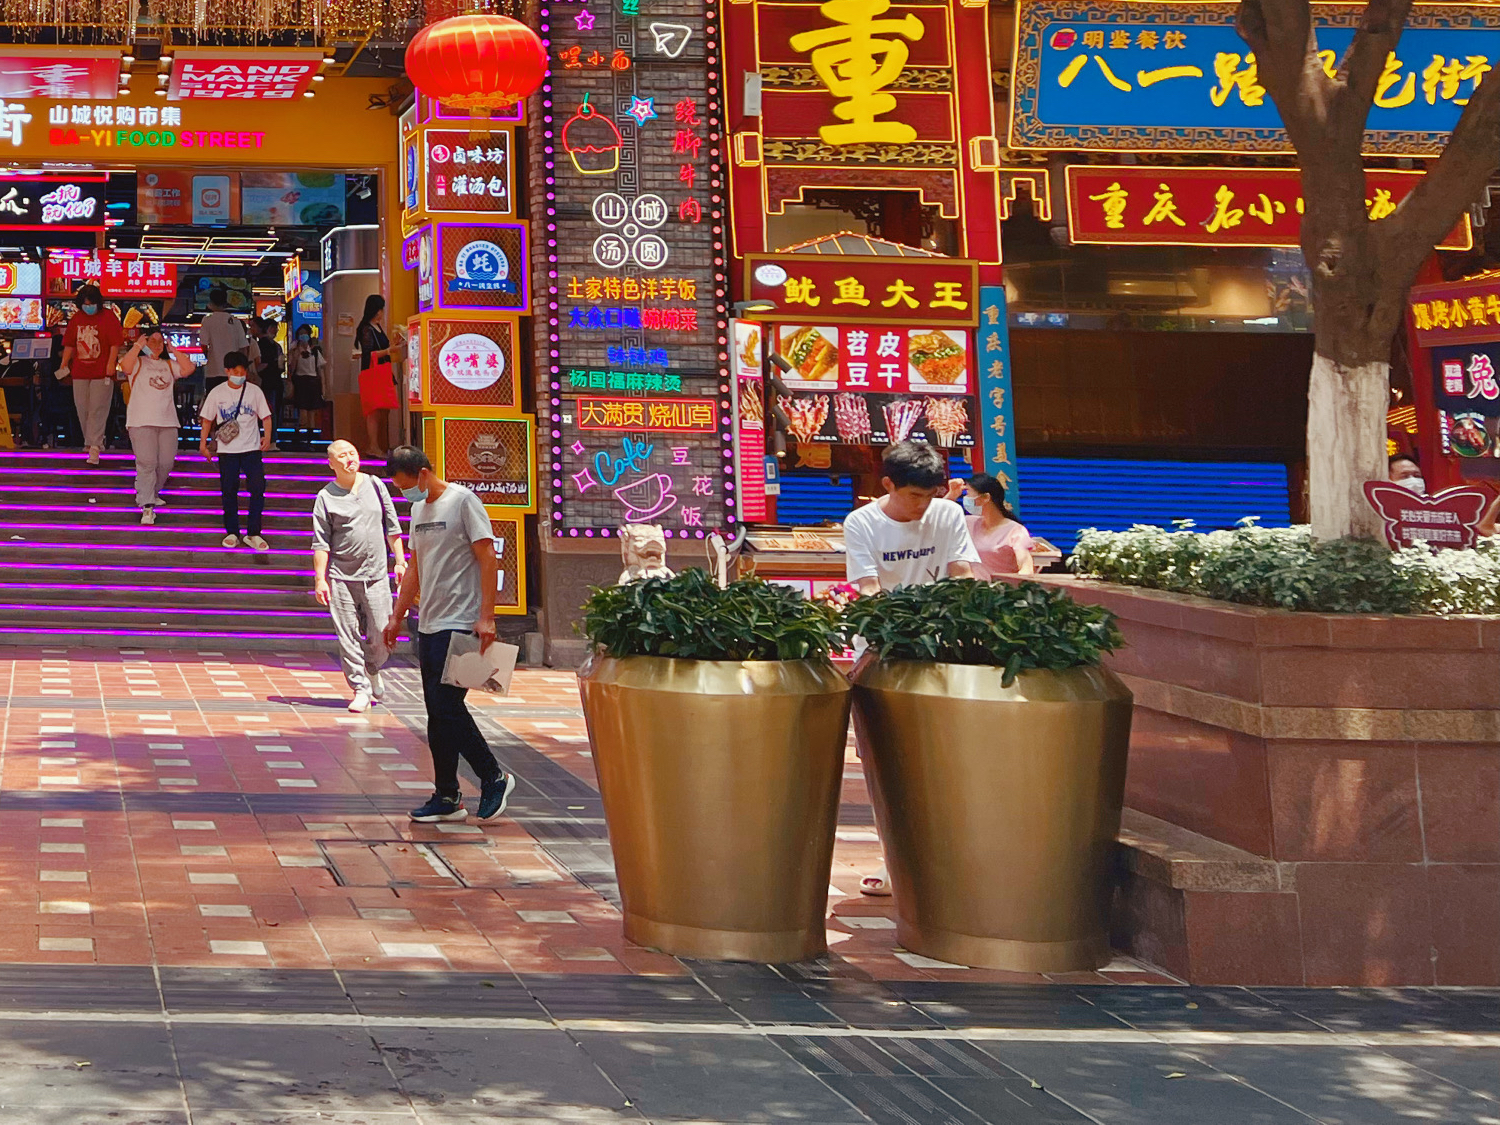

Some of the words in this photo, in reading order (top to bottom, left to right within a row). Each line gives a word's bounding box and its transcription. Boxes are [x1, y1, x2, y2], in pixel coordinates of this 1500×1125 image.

[1081, 30, 1188, 51] 明鉴餐饮
[181, 74, 302, 83] MARK
[182, 64, 311, 74] LAND
[1057, 48, 1493, 109] 八一路吃街
[49, 106, 182, 126] 山城悦购市集
[116, 131, 176, 148] FOOD
[180, 131, 266, 148] STREET
[452, 145, 506, 165] 卤味坊
[451, 174, 506, 197] 灌汤包
[601, 198, 661, 222] 山城
[1088, 181, 1398, 233] 重庆名小城
[472, 252, 494, 272] 蚝
[600, 239, 661, 263] 汤圆
[62, 259, 166, 278] 山城羊肉串
[566, 275, 698, 301] 土家特色洋芋饭
[783, 276, 969, 311] 鱿鱼大王
[846, 330, 902, 358] 苕皮
[444, 351, 500, 369] 馋嘴婆
[569, 368, 682, 393] 杨国福麻辣烫
[845, 362, 902, 389] 豆干
[581, 401, 645, 426] 大满贯
[648, 402, 713, 428] 烧仙草
